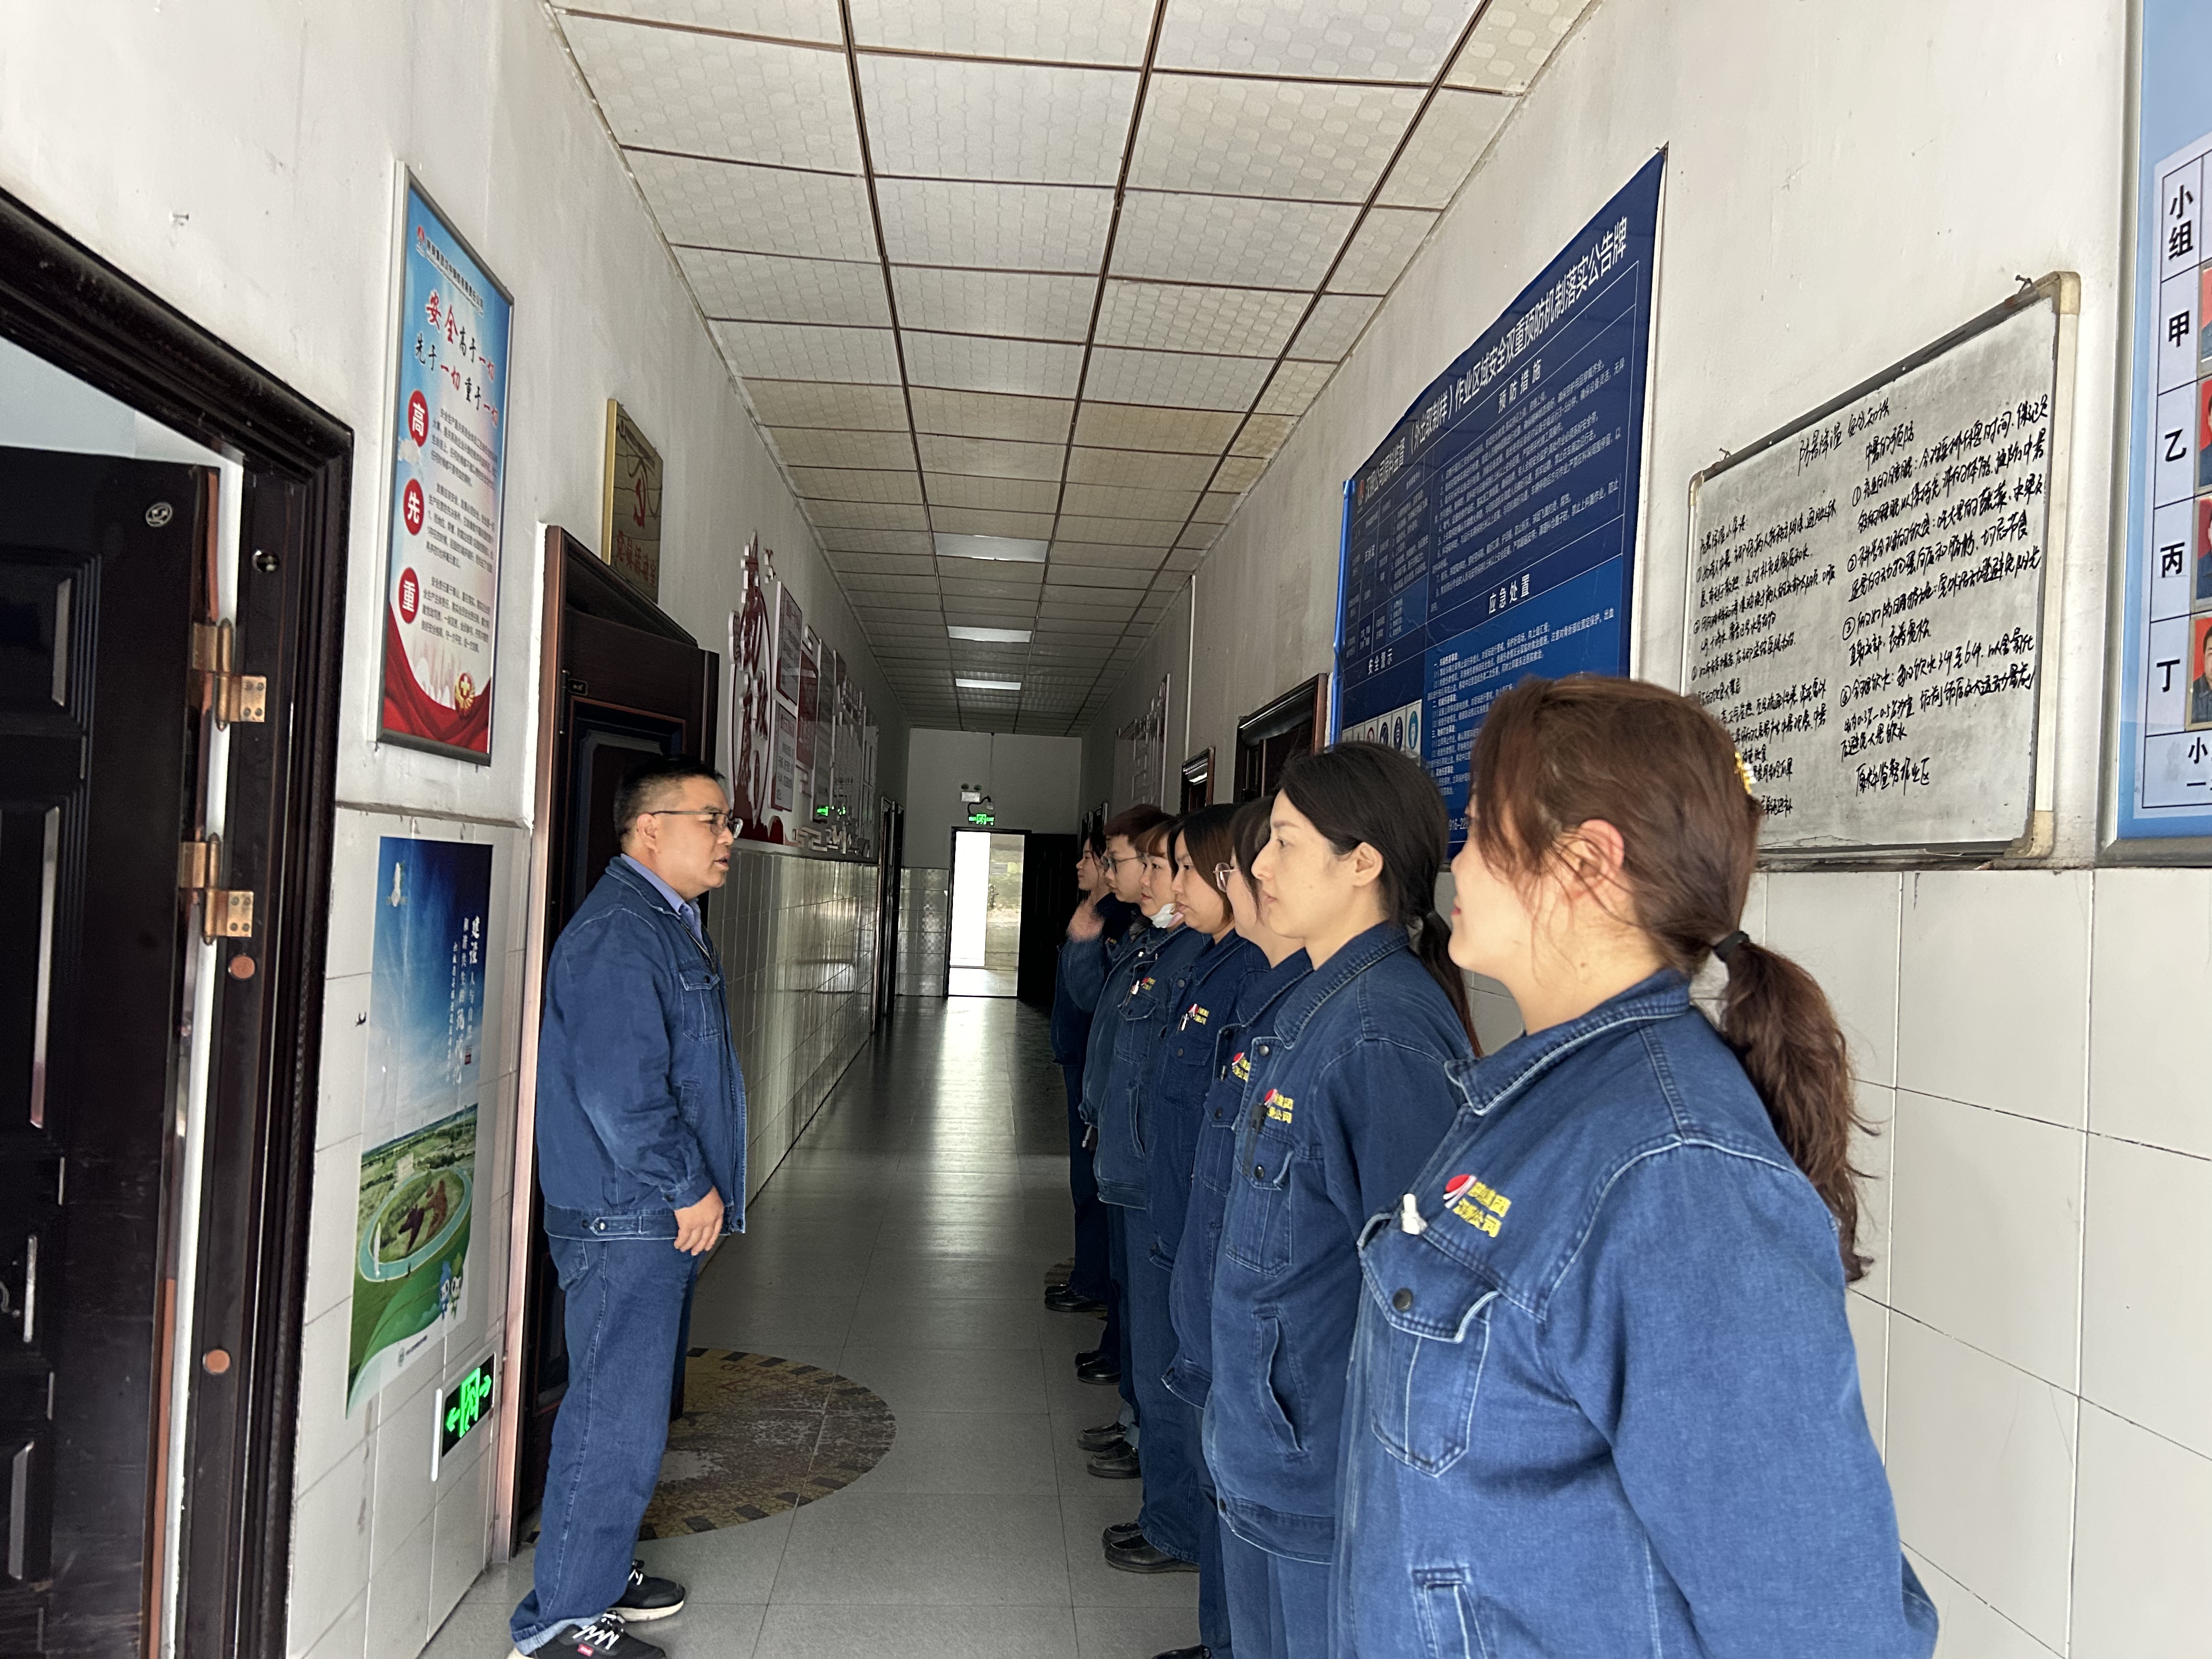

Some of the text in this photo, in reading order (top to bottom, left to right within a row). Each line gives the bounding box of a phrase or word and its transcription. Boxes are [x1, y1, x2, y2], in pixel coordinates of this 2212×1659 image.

[2169, 184, 2193, 261] 小组
[425, 289, 495, 383] 安全高于一切
[2168, 310, 2190, 348] 甲
[1498, 356, 1542, 414] 预防措施
[412, 400, 424, 438] 高
[2164, 428, 2187, 462] 乙
[407, 490, 420, 526] 先
[2160, 541, 2185, 578] 丙
[402, 579, 415, 613] 重
[1488, 573, 1531, 615] 应急处置
[1368, 647, 1392, 675] 安全警示
[2156, 658, 2180, 693] 丁
[2187, 736, 2212, 766] 小
